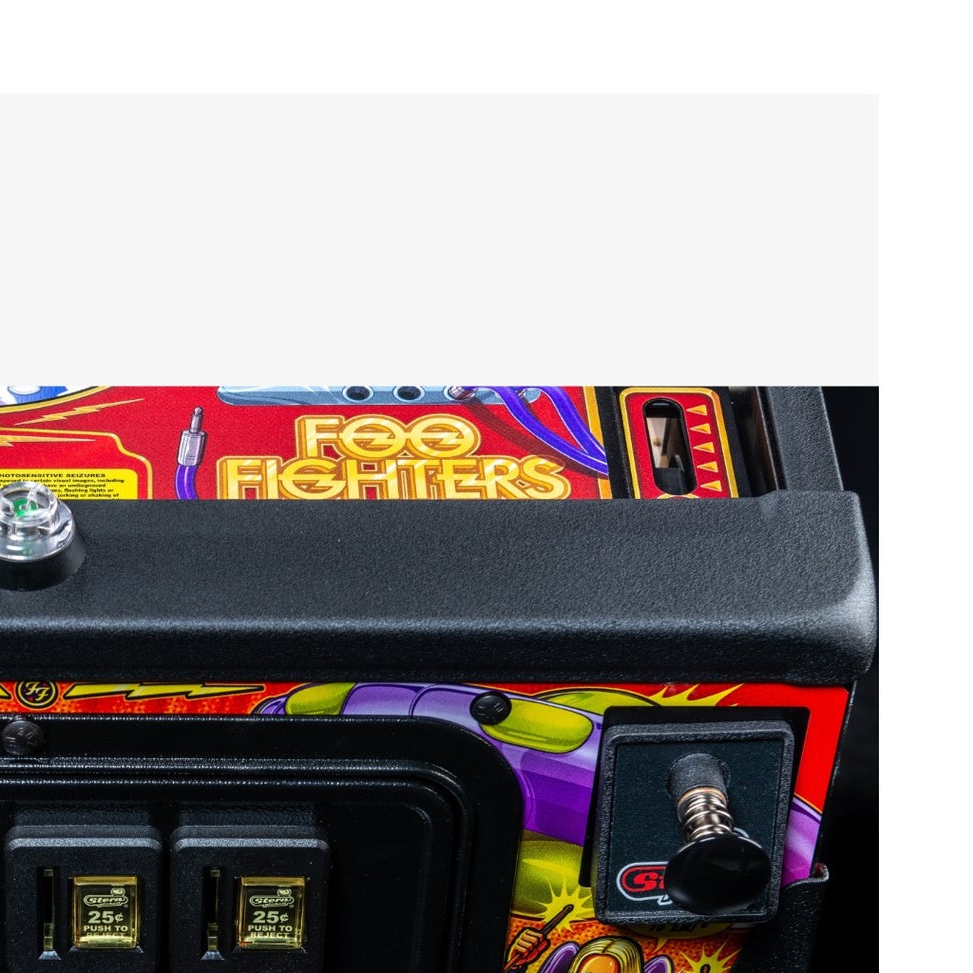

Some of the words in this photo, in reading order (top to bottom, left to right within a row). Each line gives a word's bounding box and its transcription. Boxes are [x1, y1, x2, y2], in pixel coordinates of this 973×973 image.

[295, 414, 480, 458] FOO
[217, 456, 571, 499] FIGHTERS
[88, 910, 124, 924] 25¢
[252, 910, 288, 924] 25¢
